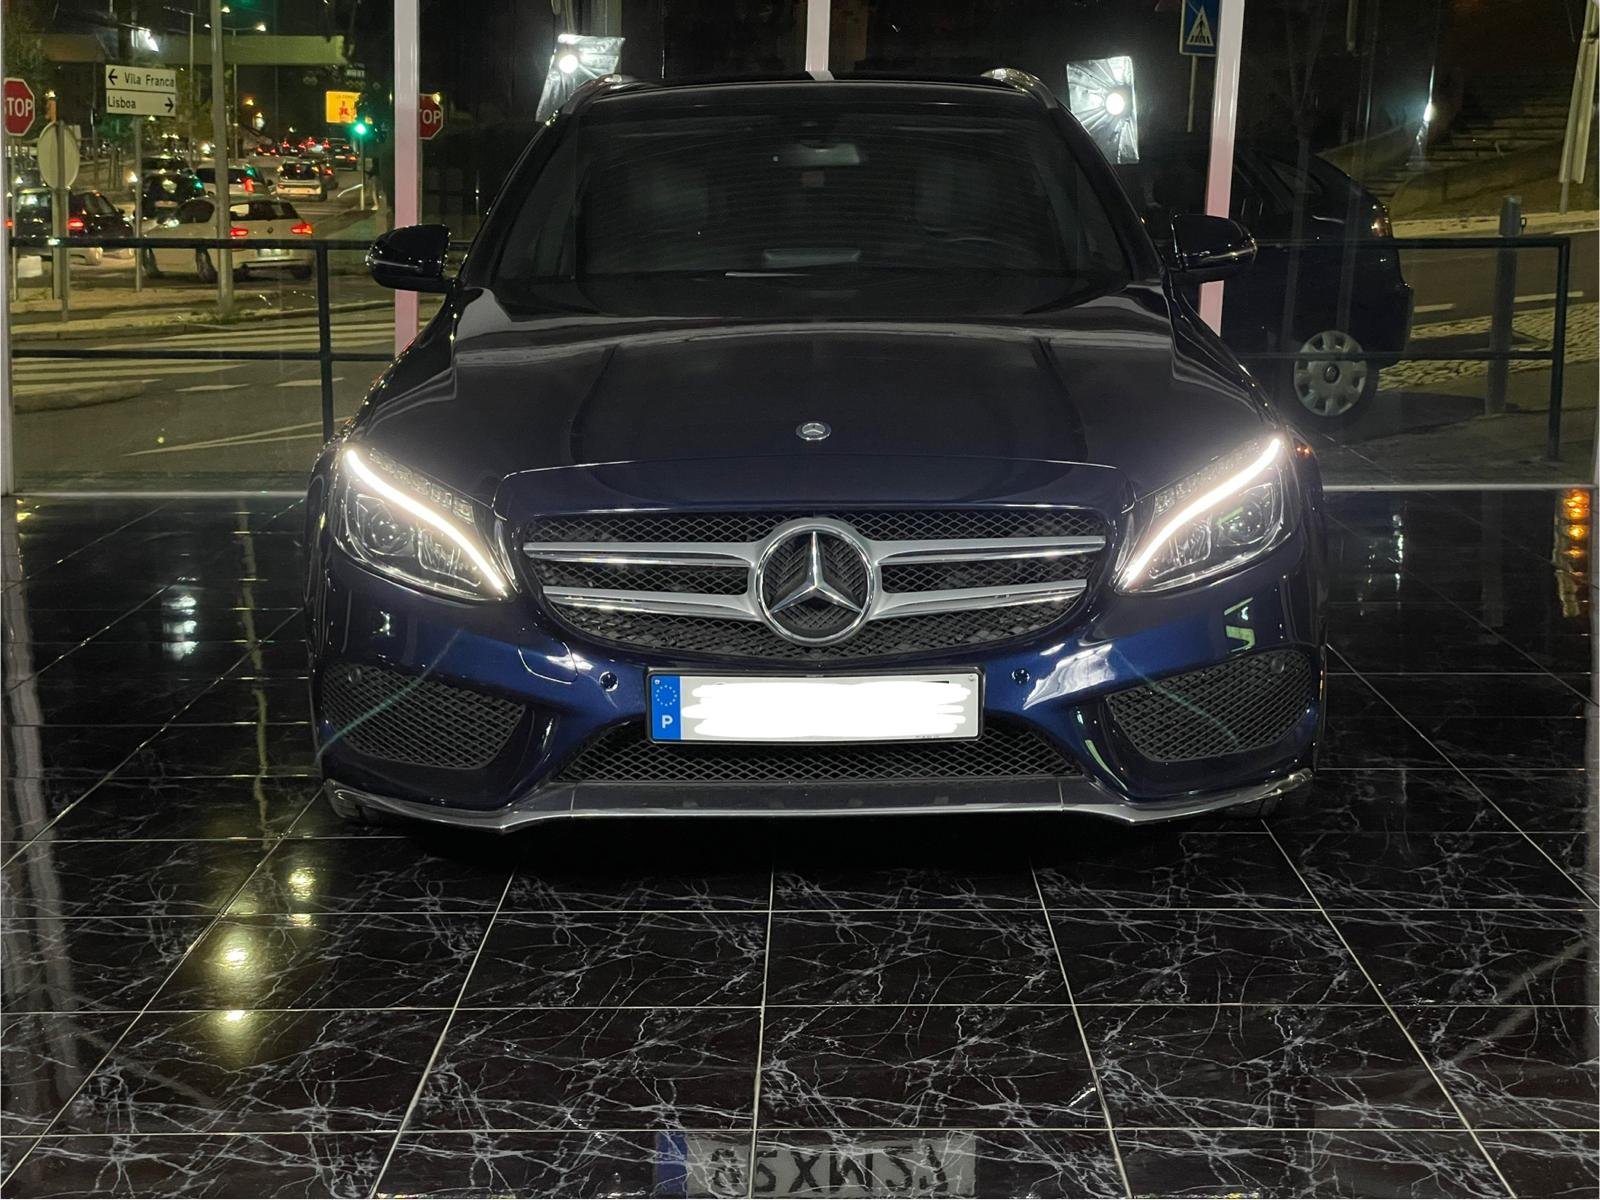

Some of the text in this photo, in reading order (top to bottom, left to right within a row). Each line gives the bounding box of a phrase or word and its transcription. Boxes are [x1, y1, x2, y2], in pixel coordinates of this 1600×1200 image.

[124, 71, 174, 88] Vila Franca
[108, 95, 136, 109] Lisboa
[662, 715, 673, 728] P
